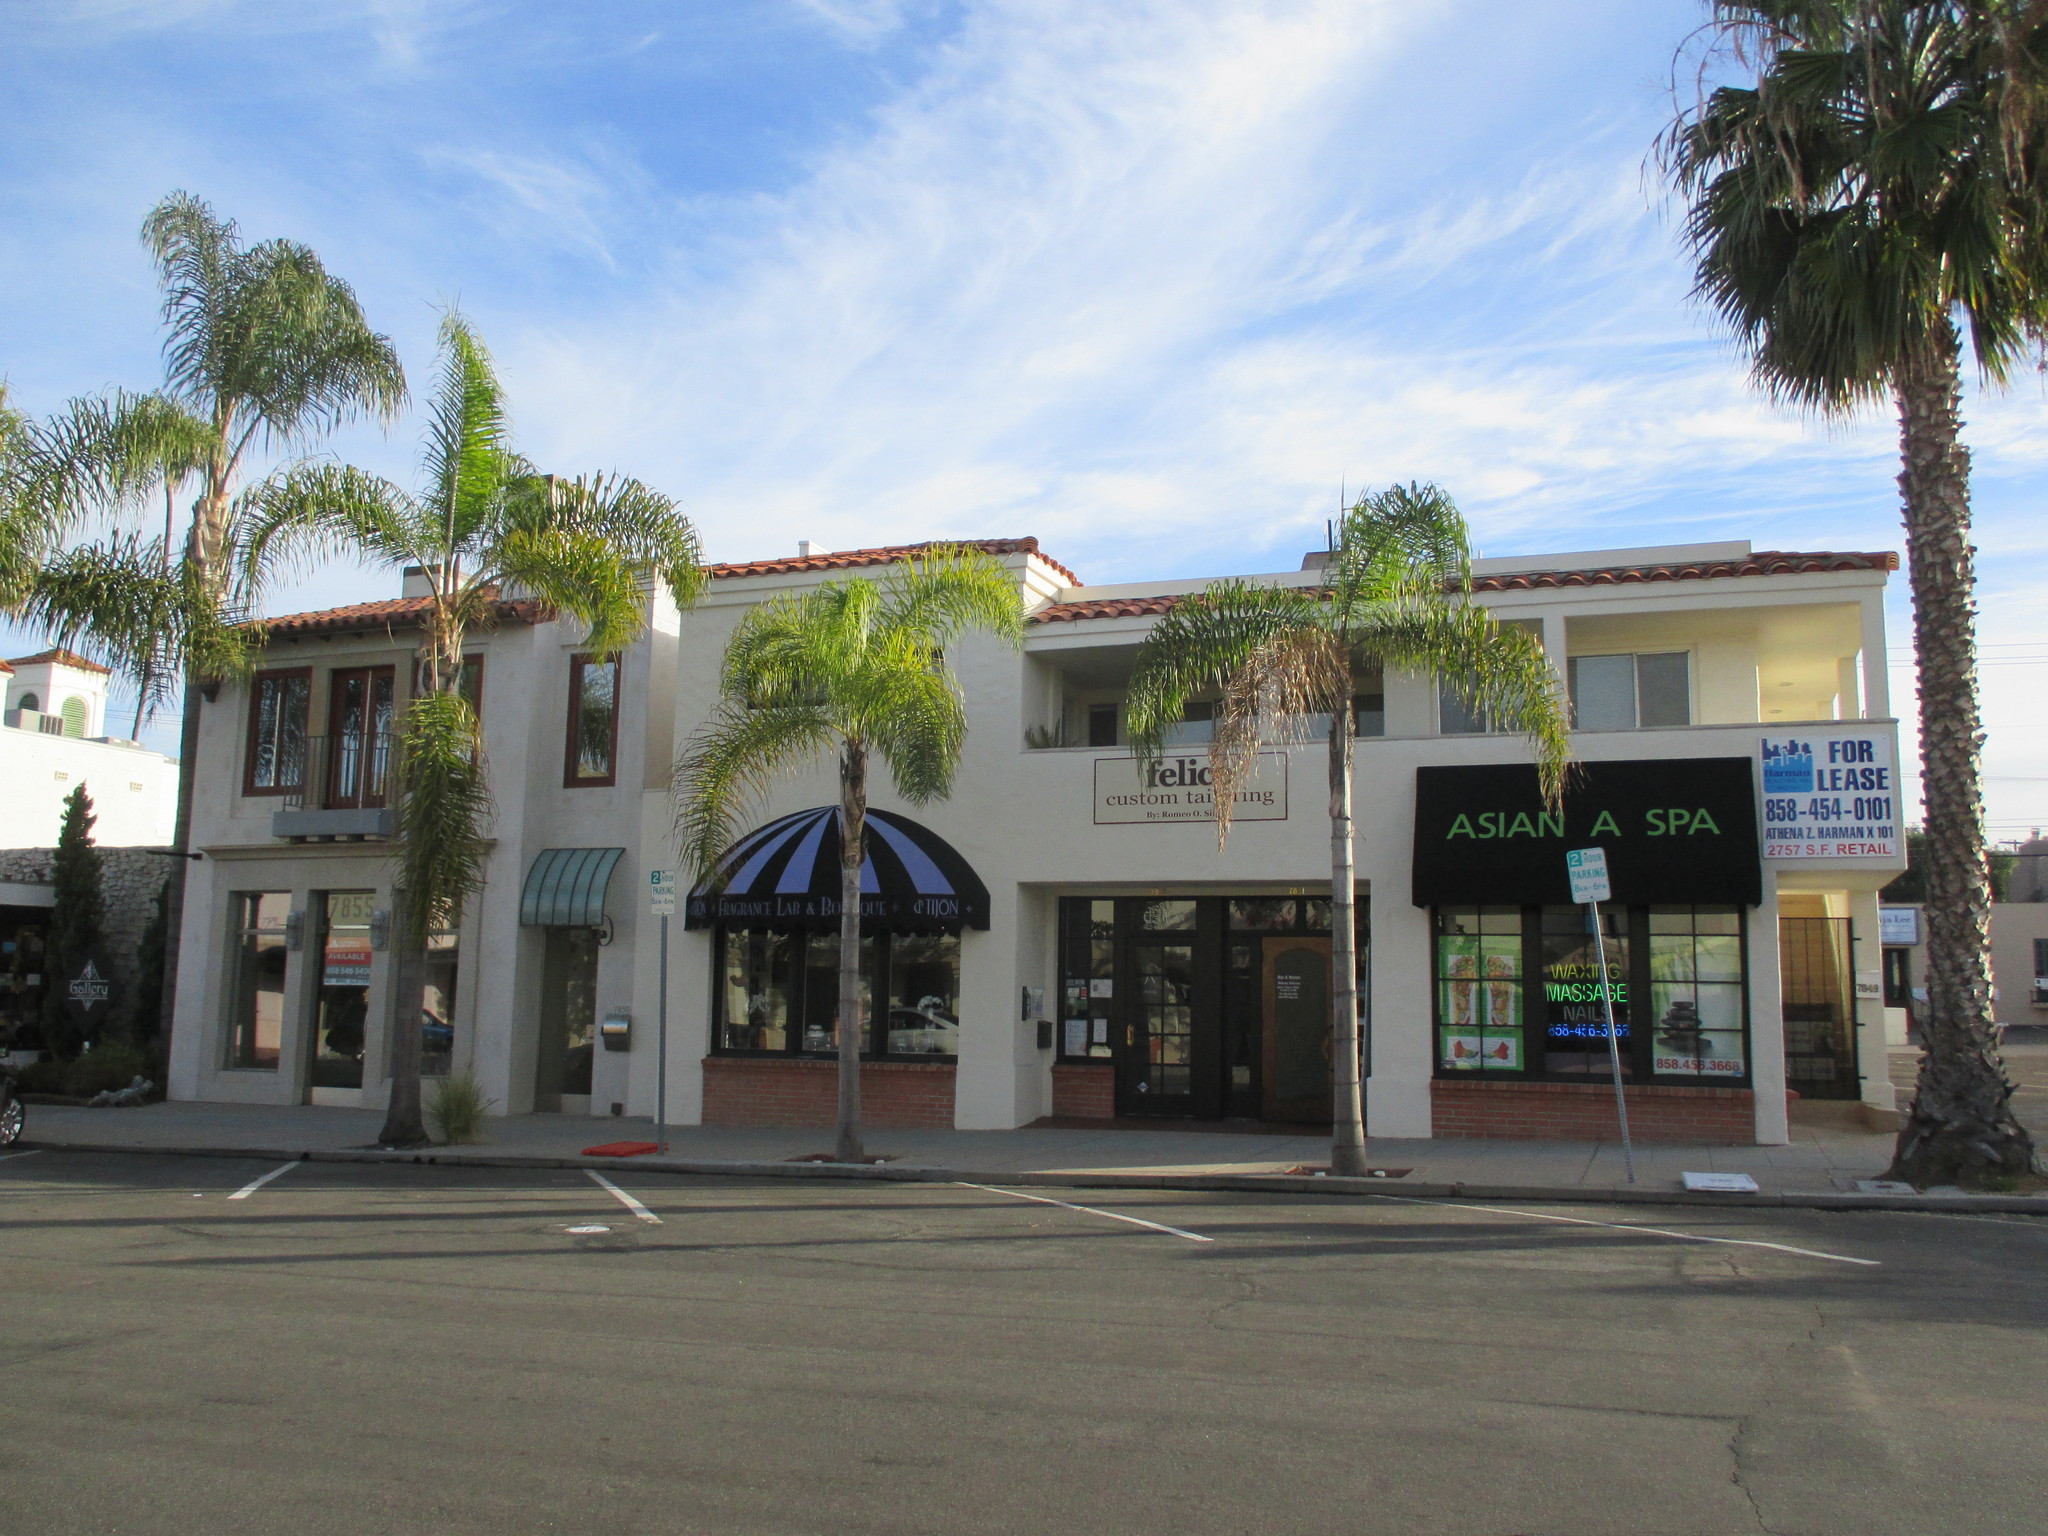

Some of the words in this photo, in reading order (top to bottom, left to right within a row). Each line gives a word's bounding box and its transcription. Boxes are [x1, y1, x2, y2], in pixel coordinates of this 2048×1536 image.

[1828, 740, 1874, 763] FOR
[1146, 758, 1233, 788] felic
[1816, 767, 1889, 791] LEASE
[1106, 792, 1178, 807] custom
[1186, 787, 1275, 806] tairing
[1162, 810, 1191, 818] Romeo
[1765, 797, 1892, 822] 858-454-0101
[1446, 811, 1566, 840] ASIAN
[1590, 810, 1622, 837] A
[1645, 808, 1721, 836] SPA
[1765, 827, 1804, 840] ATHENA
[1806, 826, 1816, 840] Z.
[1817, 826, 1864, 839] HARMAN
[1866, 826, 1875, 838] X
[1877, 825, 1894, 838] 101
[1767, 844, 1801, 856] 2757
[1806, 843, 1832, 855] S.F.
[1836, 843, 1892, 855] RETAIL
[1570, 853, 1580, 865] 2
[1583, 854, 1604, 863] HOUR
[652, 872, 660, 883] 2
[1570, 867, 1607, 881] PARKING
[651, 886, 674, 895] PARKING
[329, 896, 375, 918] 7855
[805, 901, 816, 914] &
[1545, 983, 1628, 1002] MASSAGE
